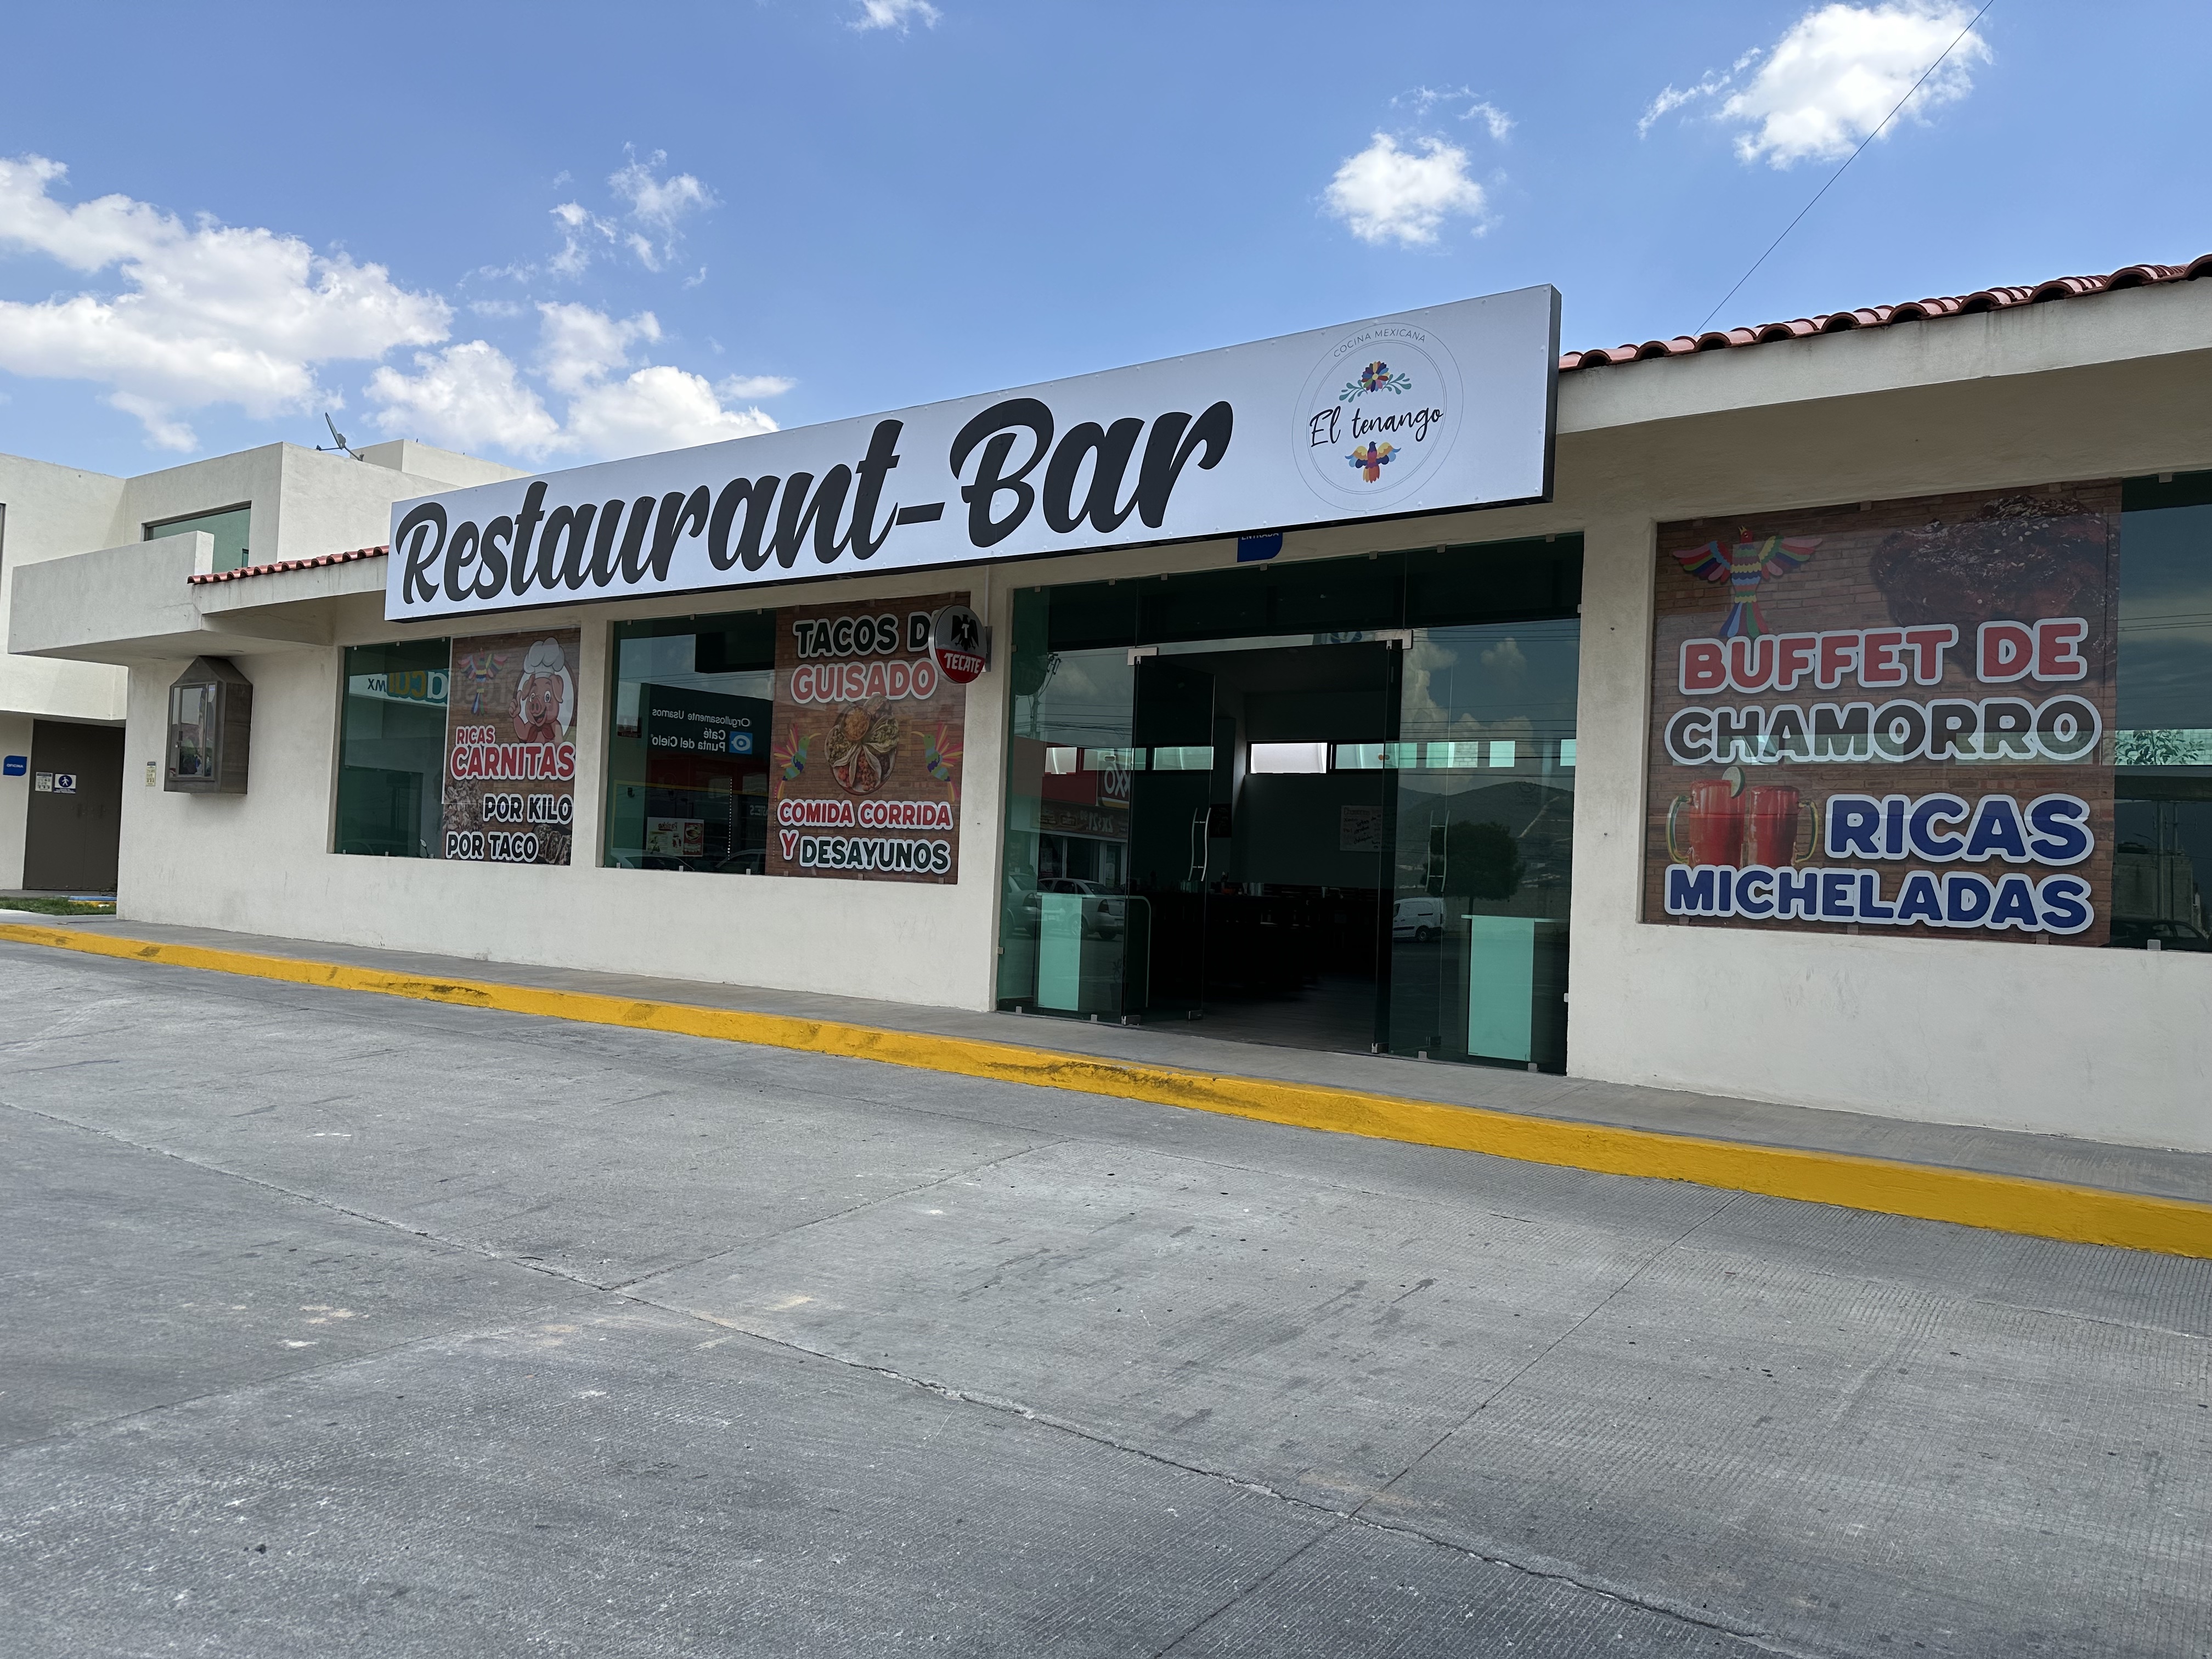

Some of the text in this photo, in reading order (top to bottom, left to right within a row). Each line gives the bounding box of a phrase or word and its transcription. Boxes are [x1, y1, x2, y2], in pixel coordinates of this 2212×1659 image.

[1334, 328, 1426, 358] COCINA MEXICANA
[1310, 405, 1443, 447] El tenango
[396, 397, 1234, 604] Restaurant-Bar
[794, 612, 931, 657] TACOS D
[944, 652, 982, 674] TECATE
[1680, 618, 2087, 694] BUFFET DE
[791, 661, 937, 703] GUISADO
[455, 726, 495, 745] RICAS
[1666, 696, 2101, 764] CHAMORRO
[450, 743, 575, 780] CARNITAS
[483, 793, 573, 824] POR KILO
[777, 799, 952, 830] COMIDA CORRIDA
[1826, 794, 2094, 865] RICAS
[445, 831, 538, 862] POR TACO
[780, 830, 951, 873] Y DESAYUNOS
[1666, 865, 2094, 933] MICHELADAS
